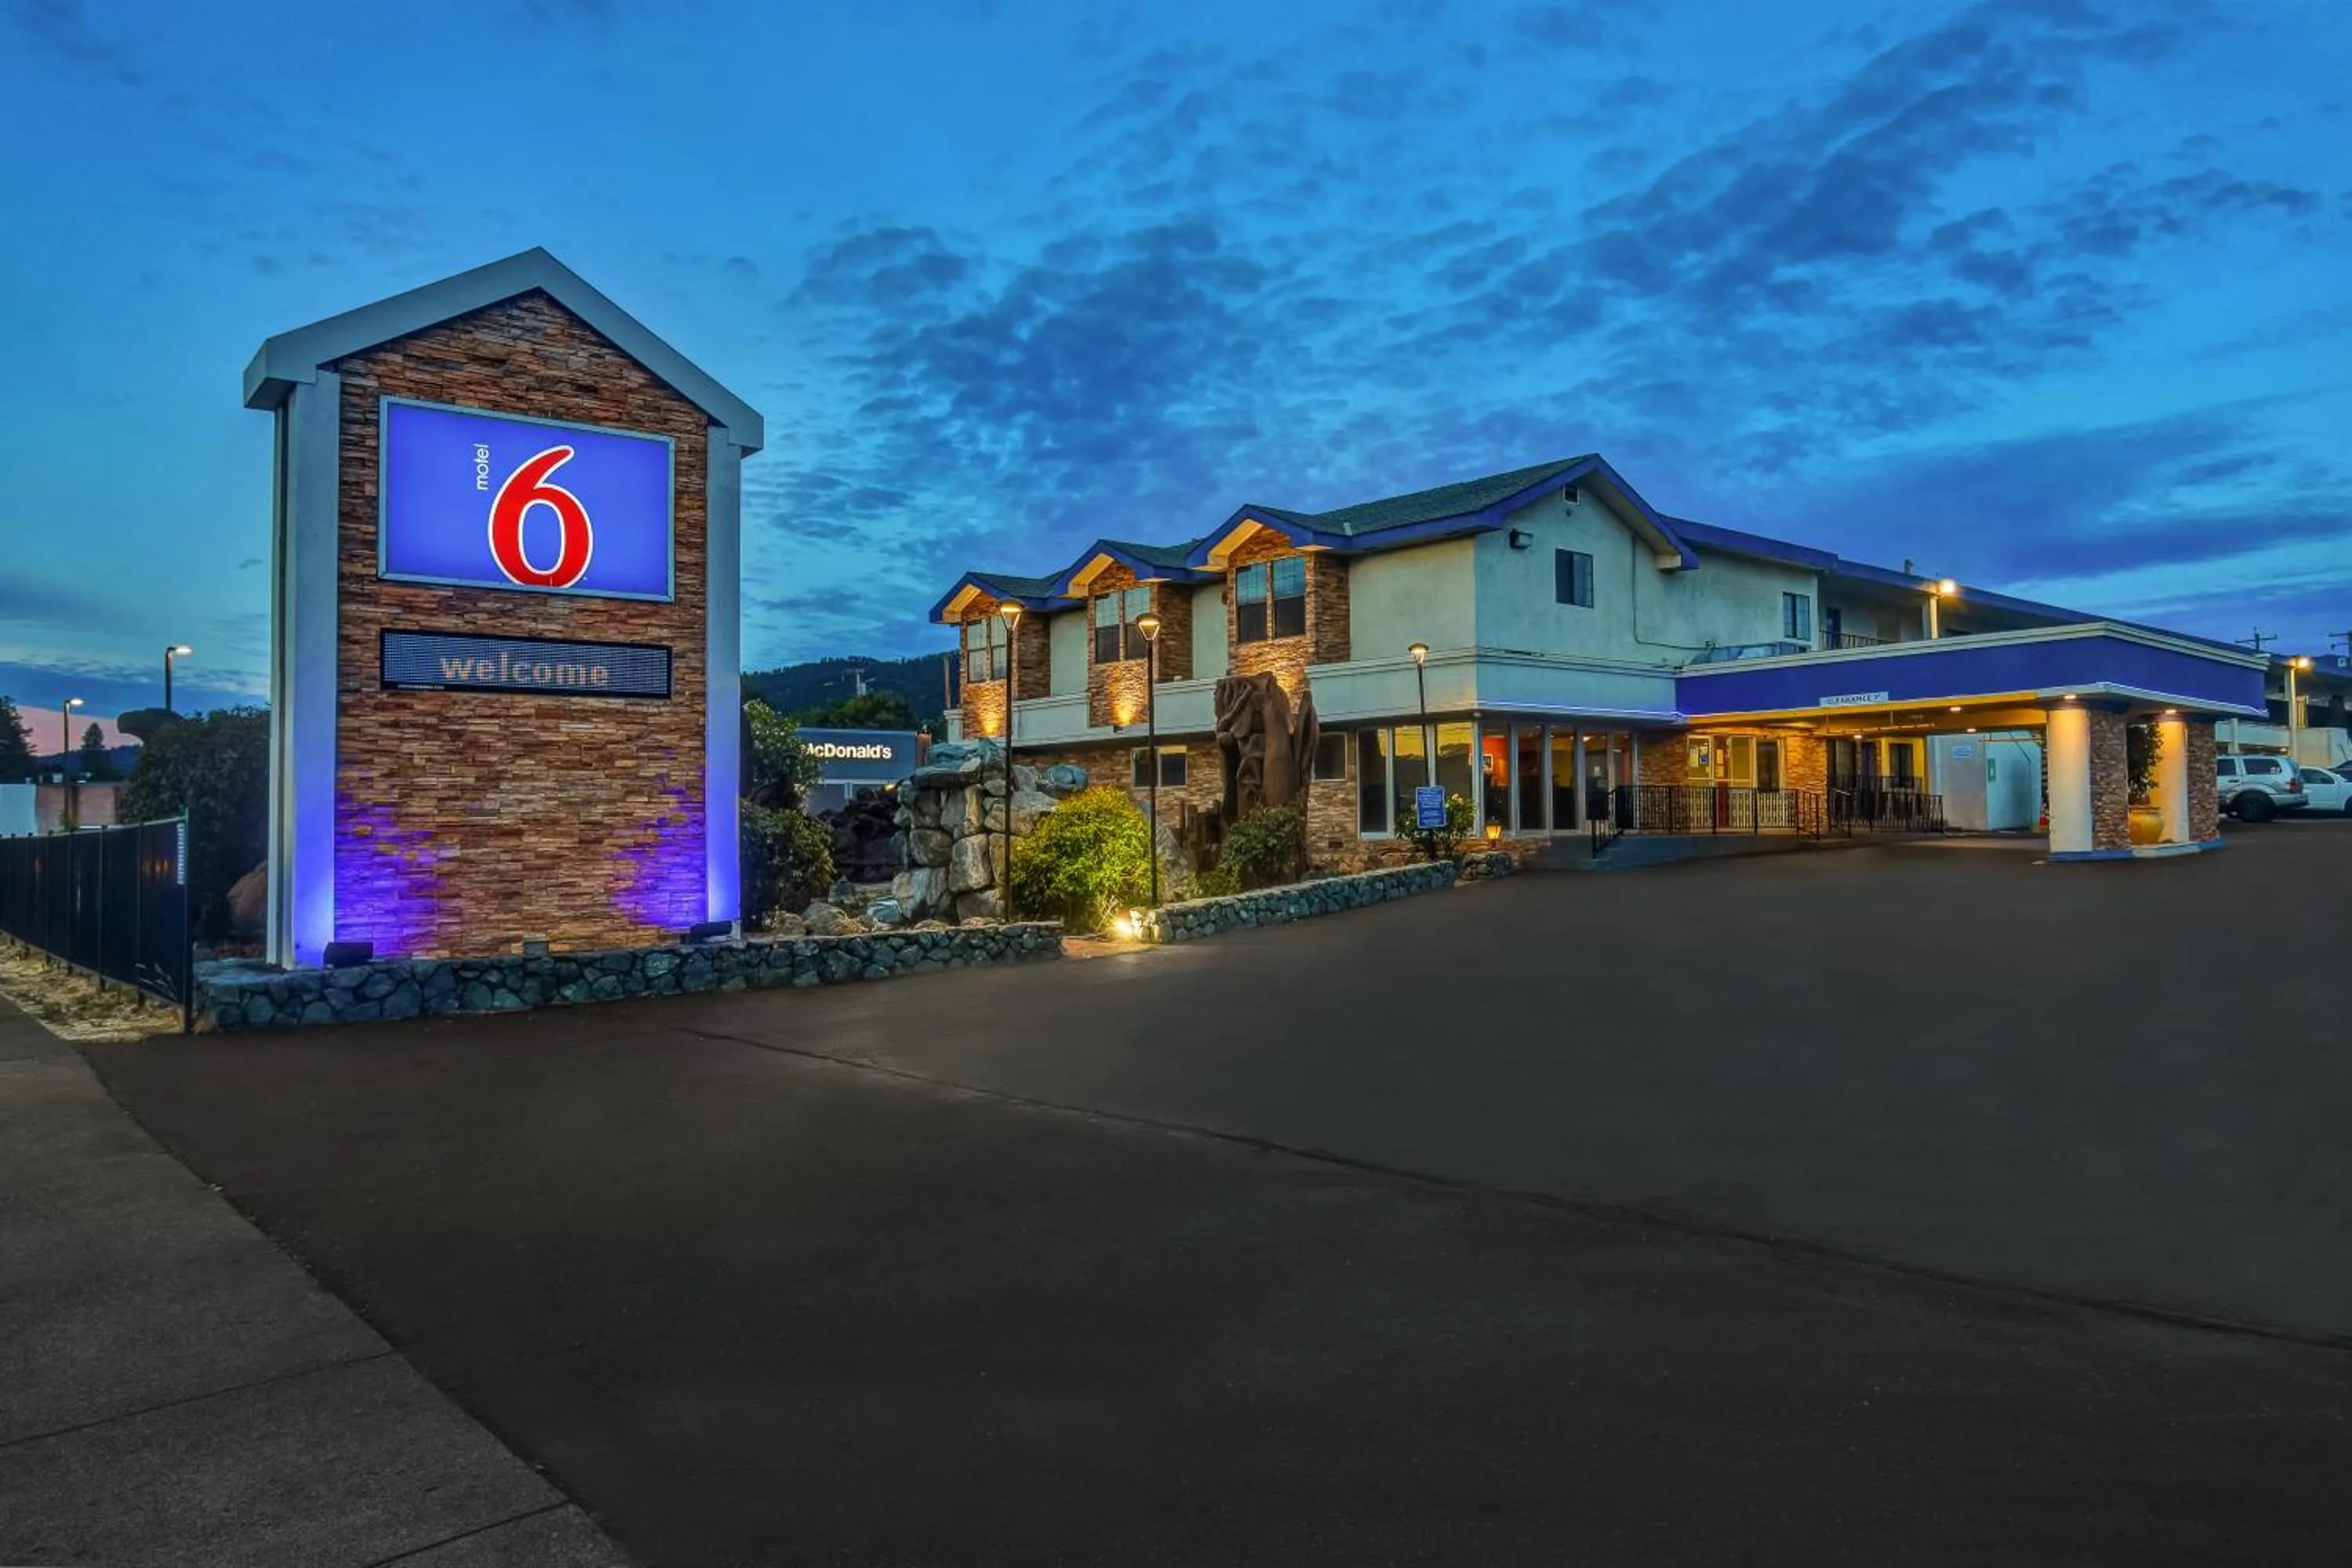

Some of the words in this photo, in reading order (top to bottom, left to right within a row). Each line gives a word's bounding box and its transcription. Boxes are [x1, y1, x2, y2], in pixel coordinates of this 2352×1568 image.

[474, 443, 489, 490] motel
[488, 445, 593, 589] 6
[440, 652, 608, 691] welcome
